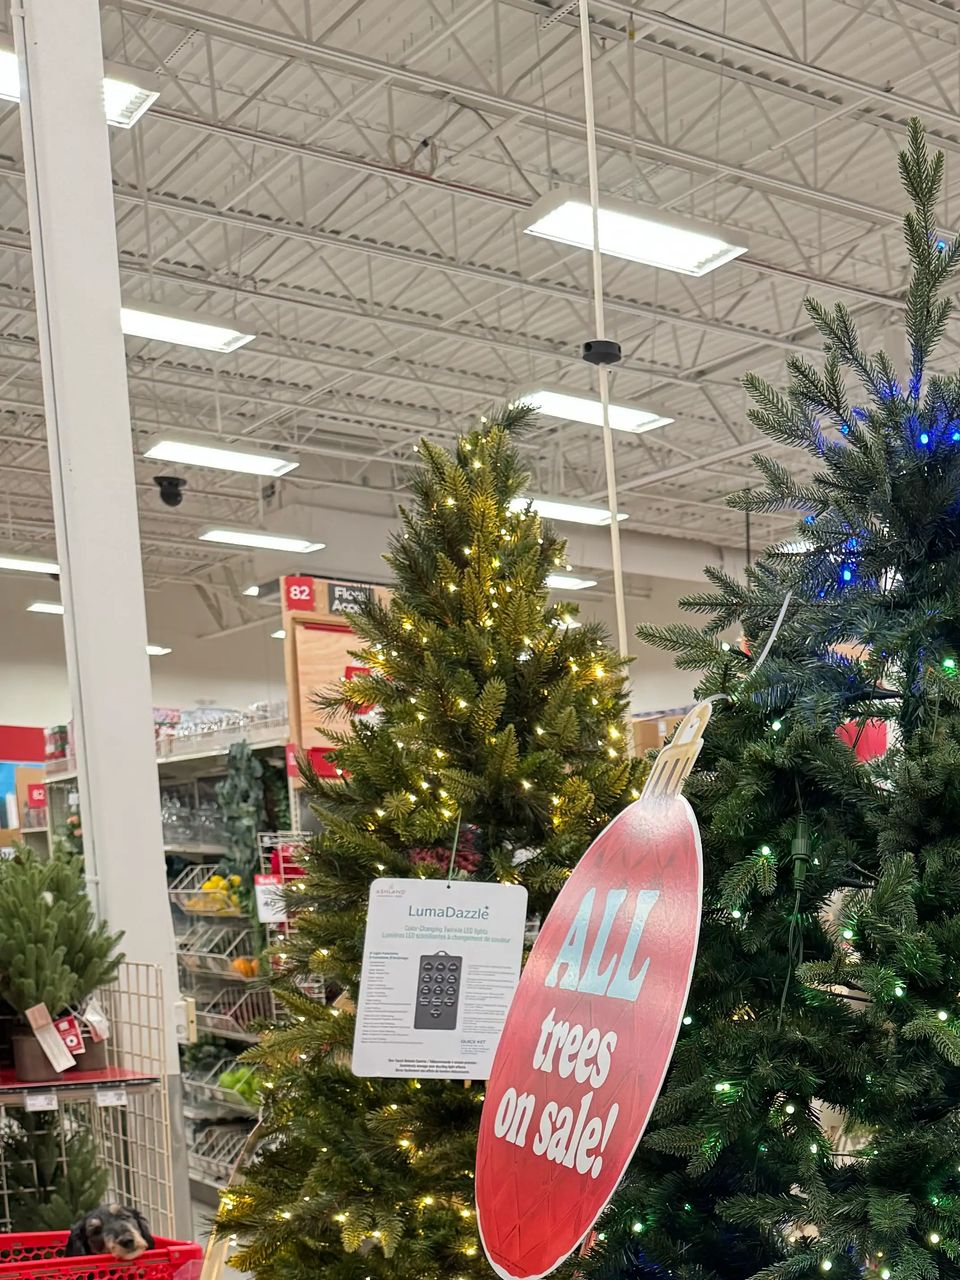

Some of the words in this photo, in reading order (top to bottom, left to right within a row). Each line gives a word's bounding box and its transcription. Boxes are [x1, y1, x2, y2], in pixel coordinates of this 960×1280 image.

[290, 585, 310, 600] 82
[409, 905, 489, 919] LumaDazzle
[545, 887, 660, 1001] ALL
[533, 1008, 617, 1089] trees
[494, 1087, 535, 1148] on
[533, 1090, 619, 1179] sale!
